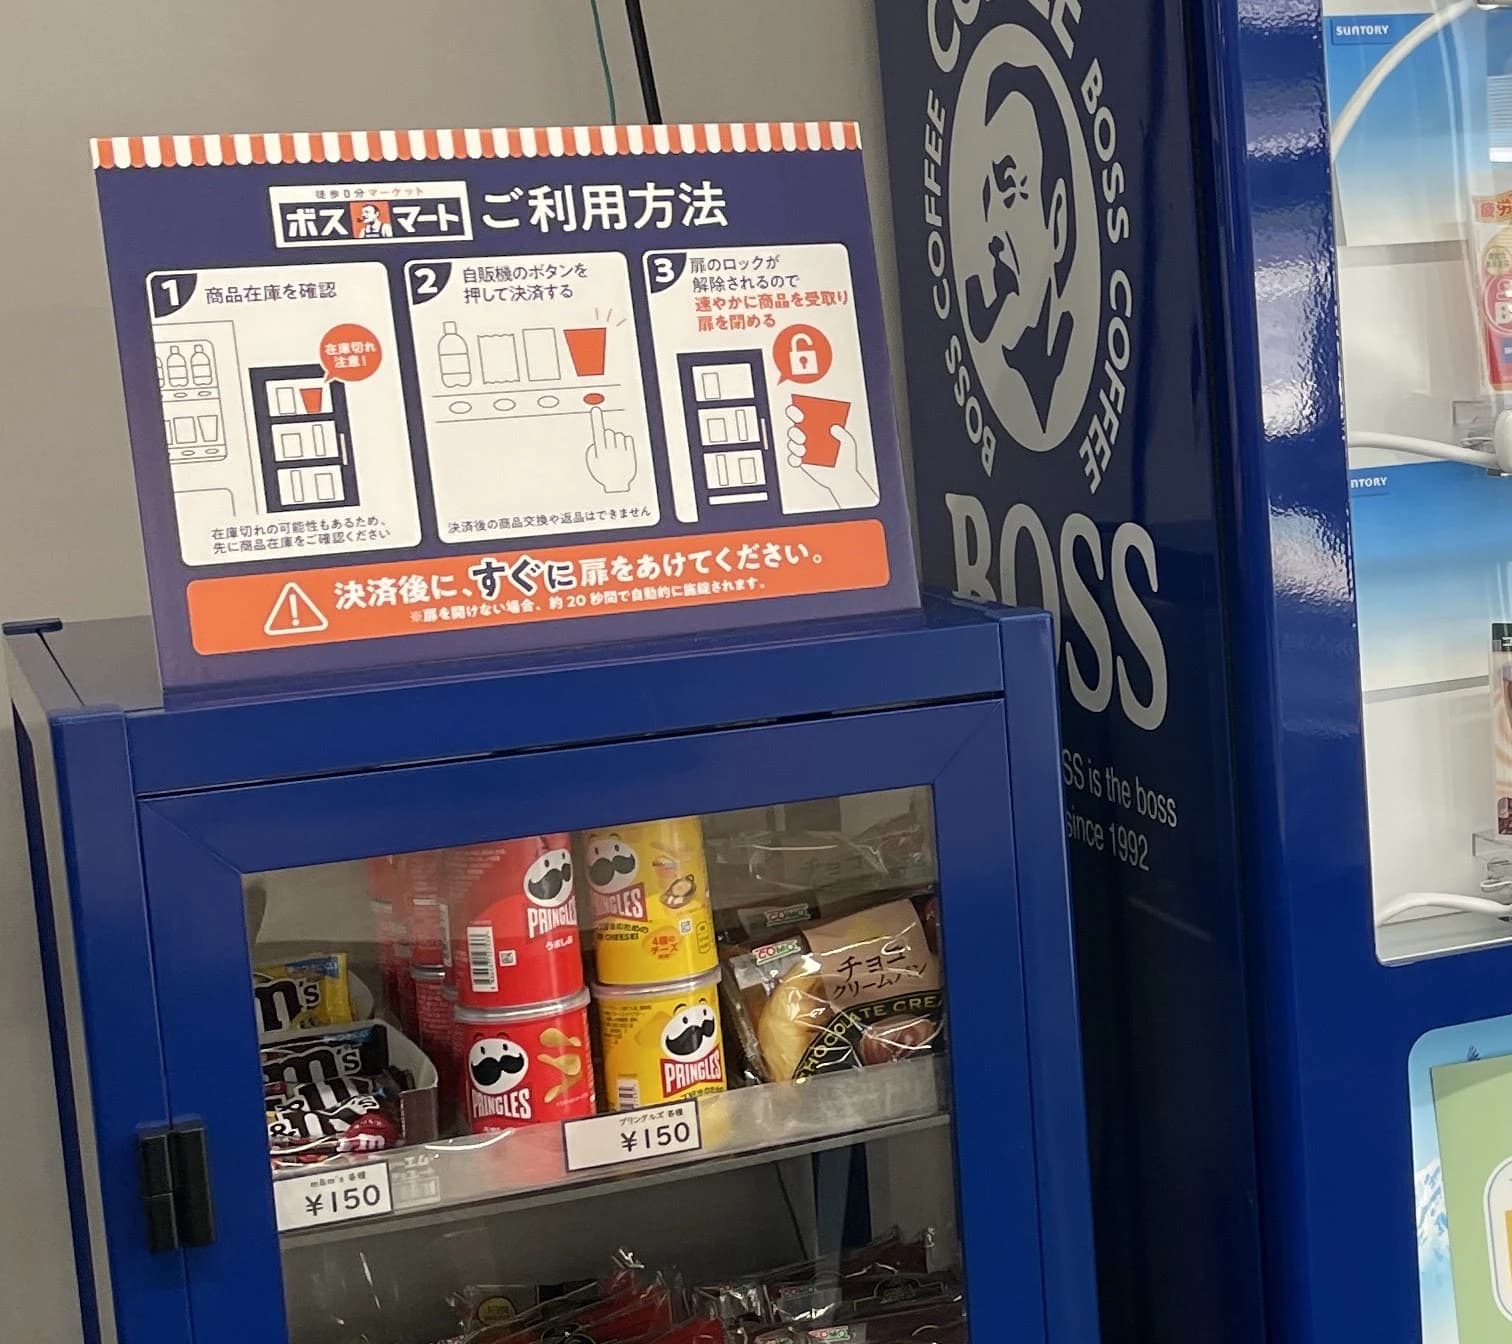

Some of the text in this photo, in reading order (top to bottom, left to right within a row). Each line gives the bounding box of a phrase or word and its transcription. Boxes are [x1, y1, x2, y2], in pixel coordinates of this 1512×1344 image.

[1335, 23, 1390, 38] SUNTORY
[285, 204, 460, 238] ボス マート
[481, 180, 729, 234] ご利用方法
[461, 263, 590, 286] 自販機のボタンを
[654, 257, 675, 284] 3
[689, 255, 781, 275] 扉のロックが
[1079, 58, 1134, 496] BOSS COFFEE
[160, 279, 180, 307] 1
[205, 281, 337, 305] 商品在庫を確認
[412, 267, 439, 295] 2
[462, 282, 575, 305] 押して決済する
[692, 274, 800, 294] 解除されるので
[930, 87, 998, 480] BOSS COFFEE
[694, 290, 849, 312] 速やかに商品を受取り
[697, 314, 777, 334] 扉を閉める
[324, 341, 377, 356] 在庫切れ
[211, 515, 388, 542] 在庫切れの可能性もあるため、
[447, 506, 653, 534] 決済後の商品交換や返品はできません
[212, 527, 392, 555] 先に商品在庫をご確認ください
[333, 542, 826, 610] 決済後に、すぐに扉をあけてください。
[945, 492, 1168, 731] BOSS
[1088, 757, 1178, 828] is the boss
[1066, 808, 1150, 872] since 1992
[664, 1050, 722, 1094] PRINGLES
[471, 1088, 532, 1120] PRINGLES
[620, 1122, 690, 1153] ¥150
[305, 1184, 380, 1216] ¥150
